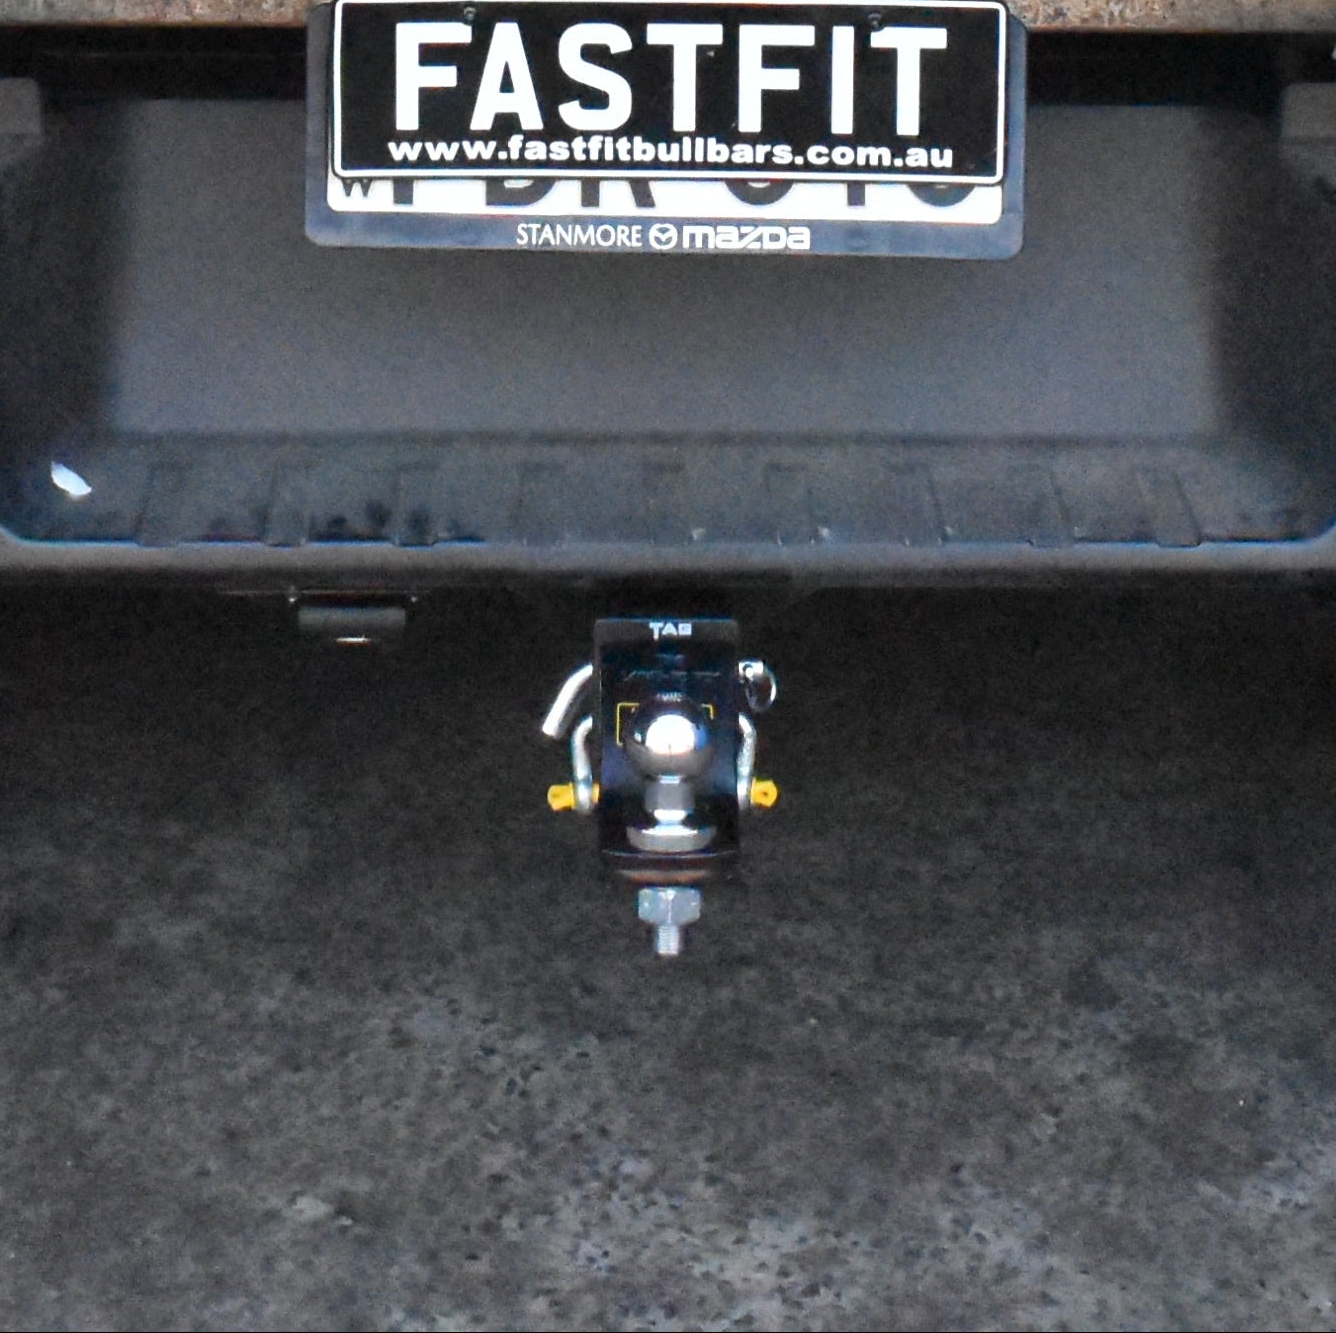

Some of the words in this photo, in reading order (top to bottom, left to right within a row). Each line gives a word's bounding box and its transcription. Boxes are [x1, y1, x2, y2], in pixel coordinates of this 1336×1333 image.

[394, 21, 949, 137] FASTFIT
[387, 135, 955, 170] www.fastfitbullbars.com.au
[516, 221, 643, 250] STANMORE
[682, 224, 811, 251] mazda
